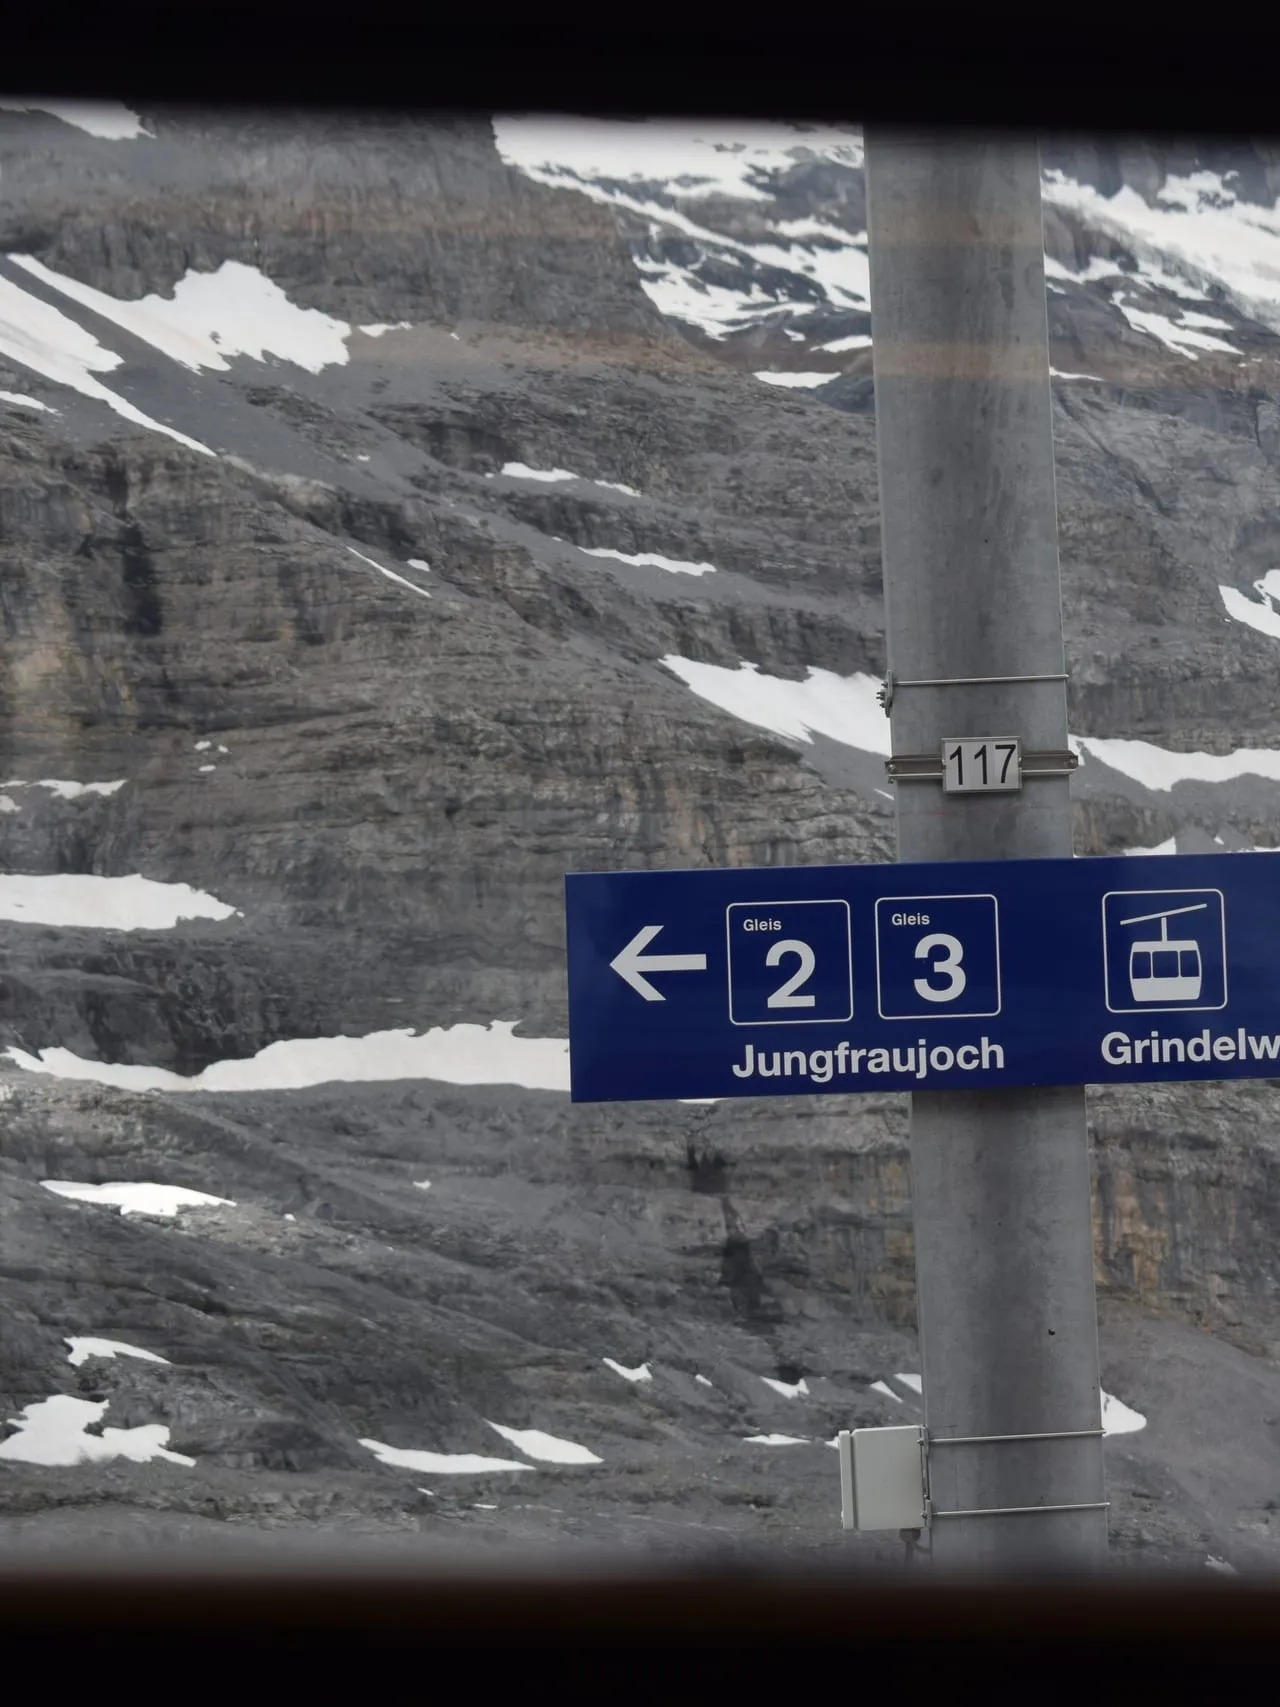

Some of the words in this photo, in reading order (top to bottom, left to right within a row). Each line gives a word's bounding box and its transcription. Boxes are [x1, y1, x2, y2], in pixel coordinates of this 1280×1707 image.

[949, 744, 1016, 785] 117
[743, 918, 782, 932] Gleis
[891, 912, 930, 926] Gleis
[765, 939, 816, 1009] 2
[913, 933, 967, 1003] 3
[732, 1036, 1005, 1083] Jungfraujoch
